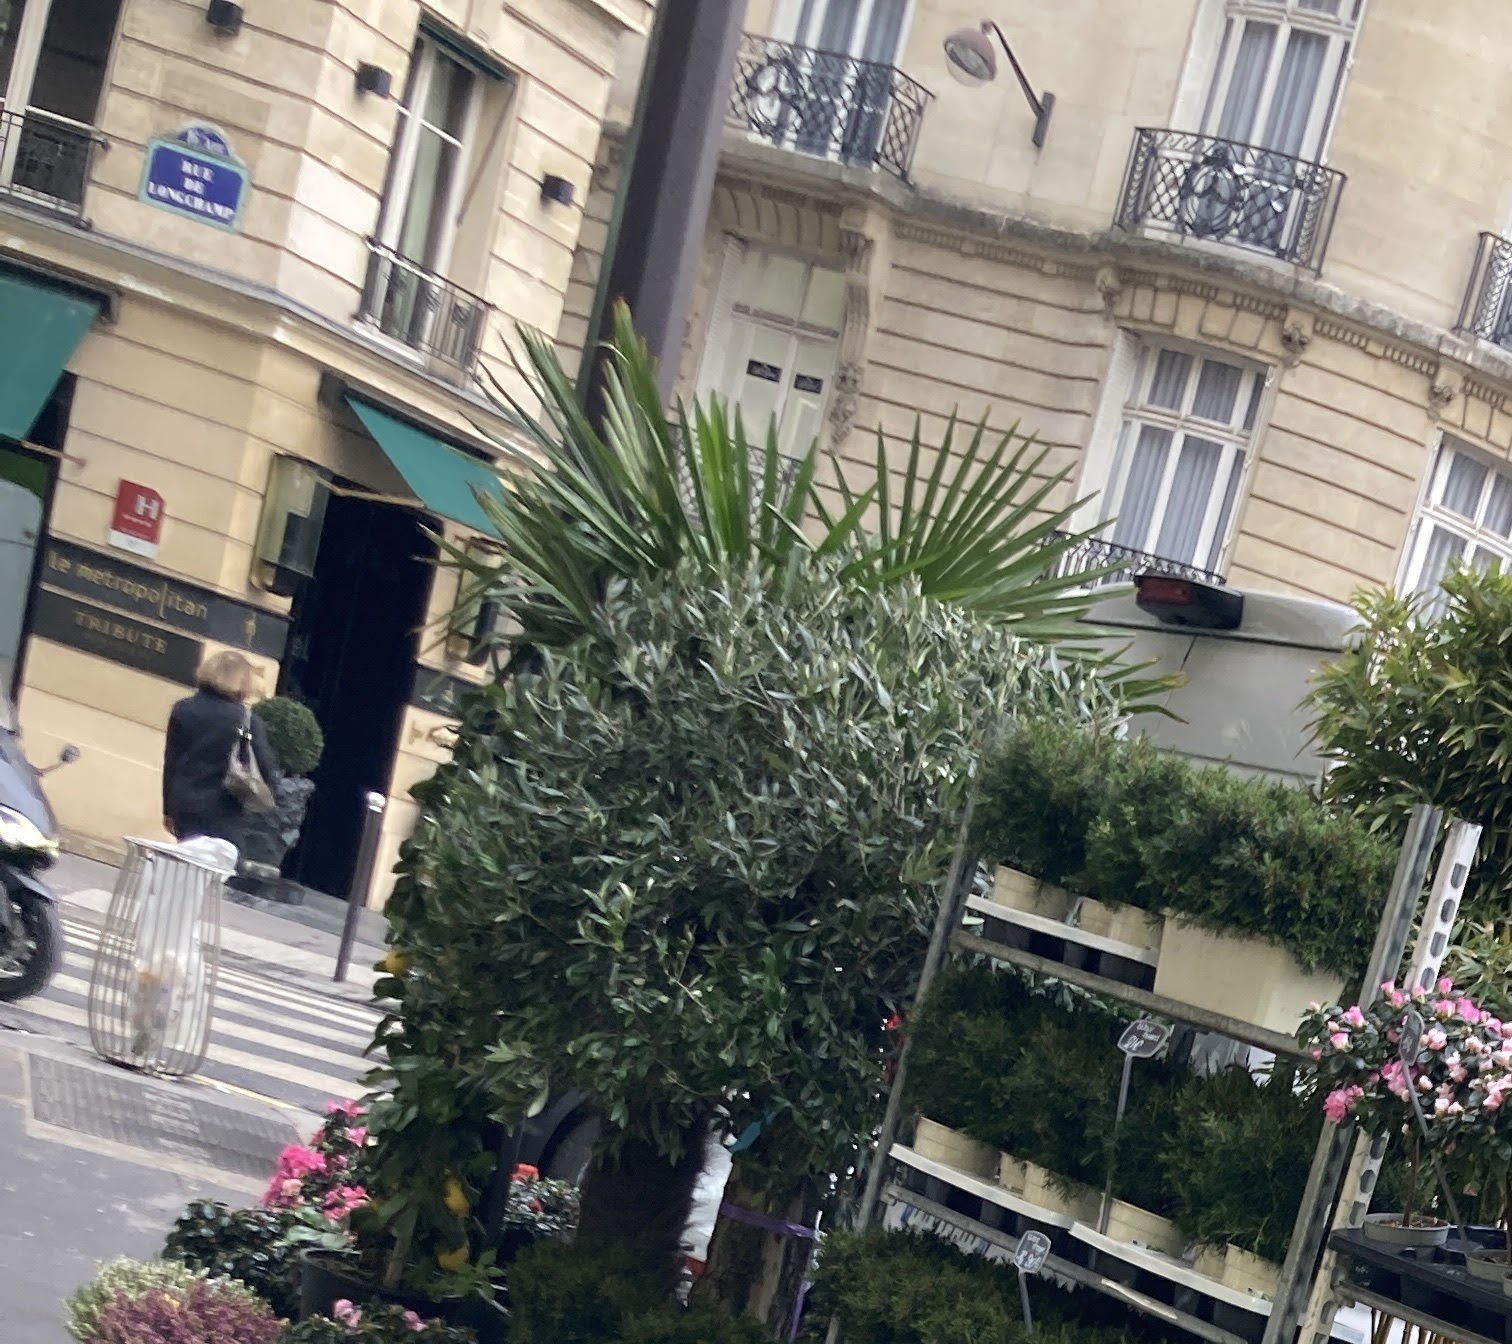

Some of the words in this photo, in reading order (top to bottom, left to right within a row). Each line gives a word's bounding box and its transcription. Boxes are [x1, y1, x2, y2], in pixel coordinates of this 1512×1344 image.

[181, 159, 215, 183] RUE
[147, 181, 236, 220] LONGCHAMP
[183, 177, 206, 197] DE
[71, 609, 168, 655] TRIBUTE
